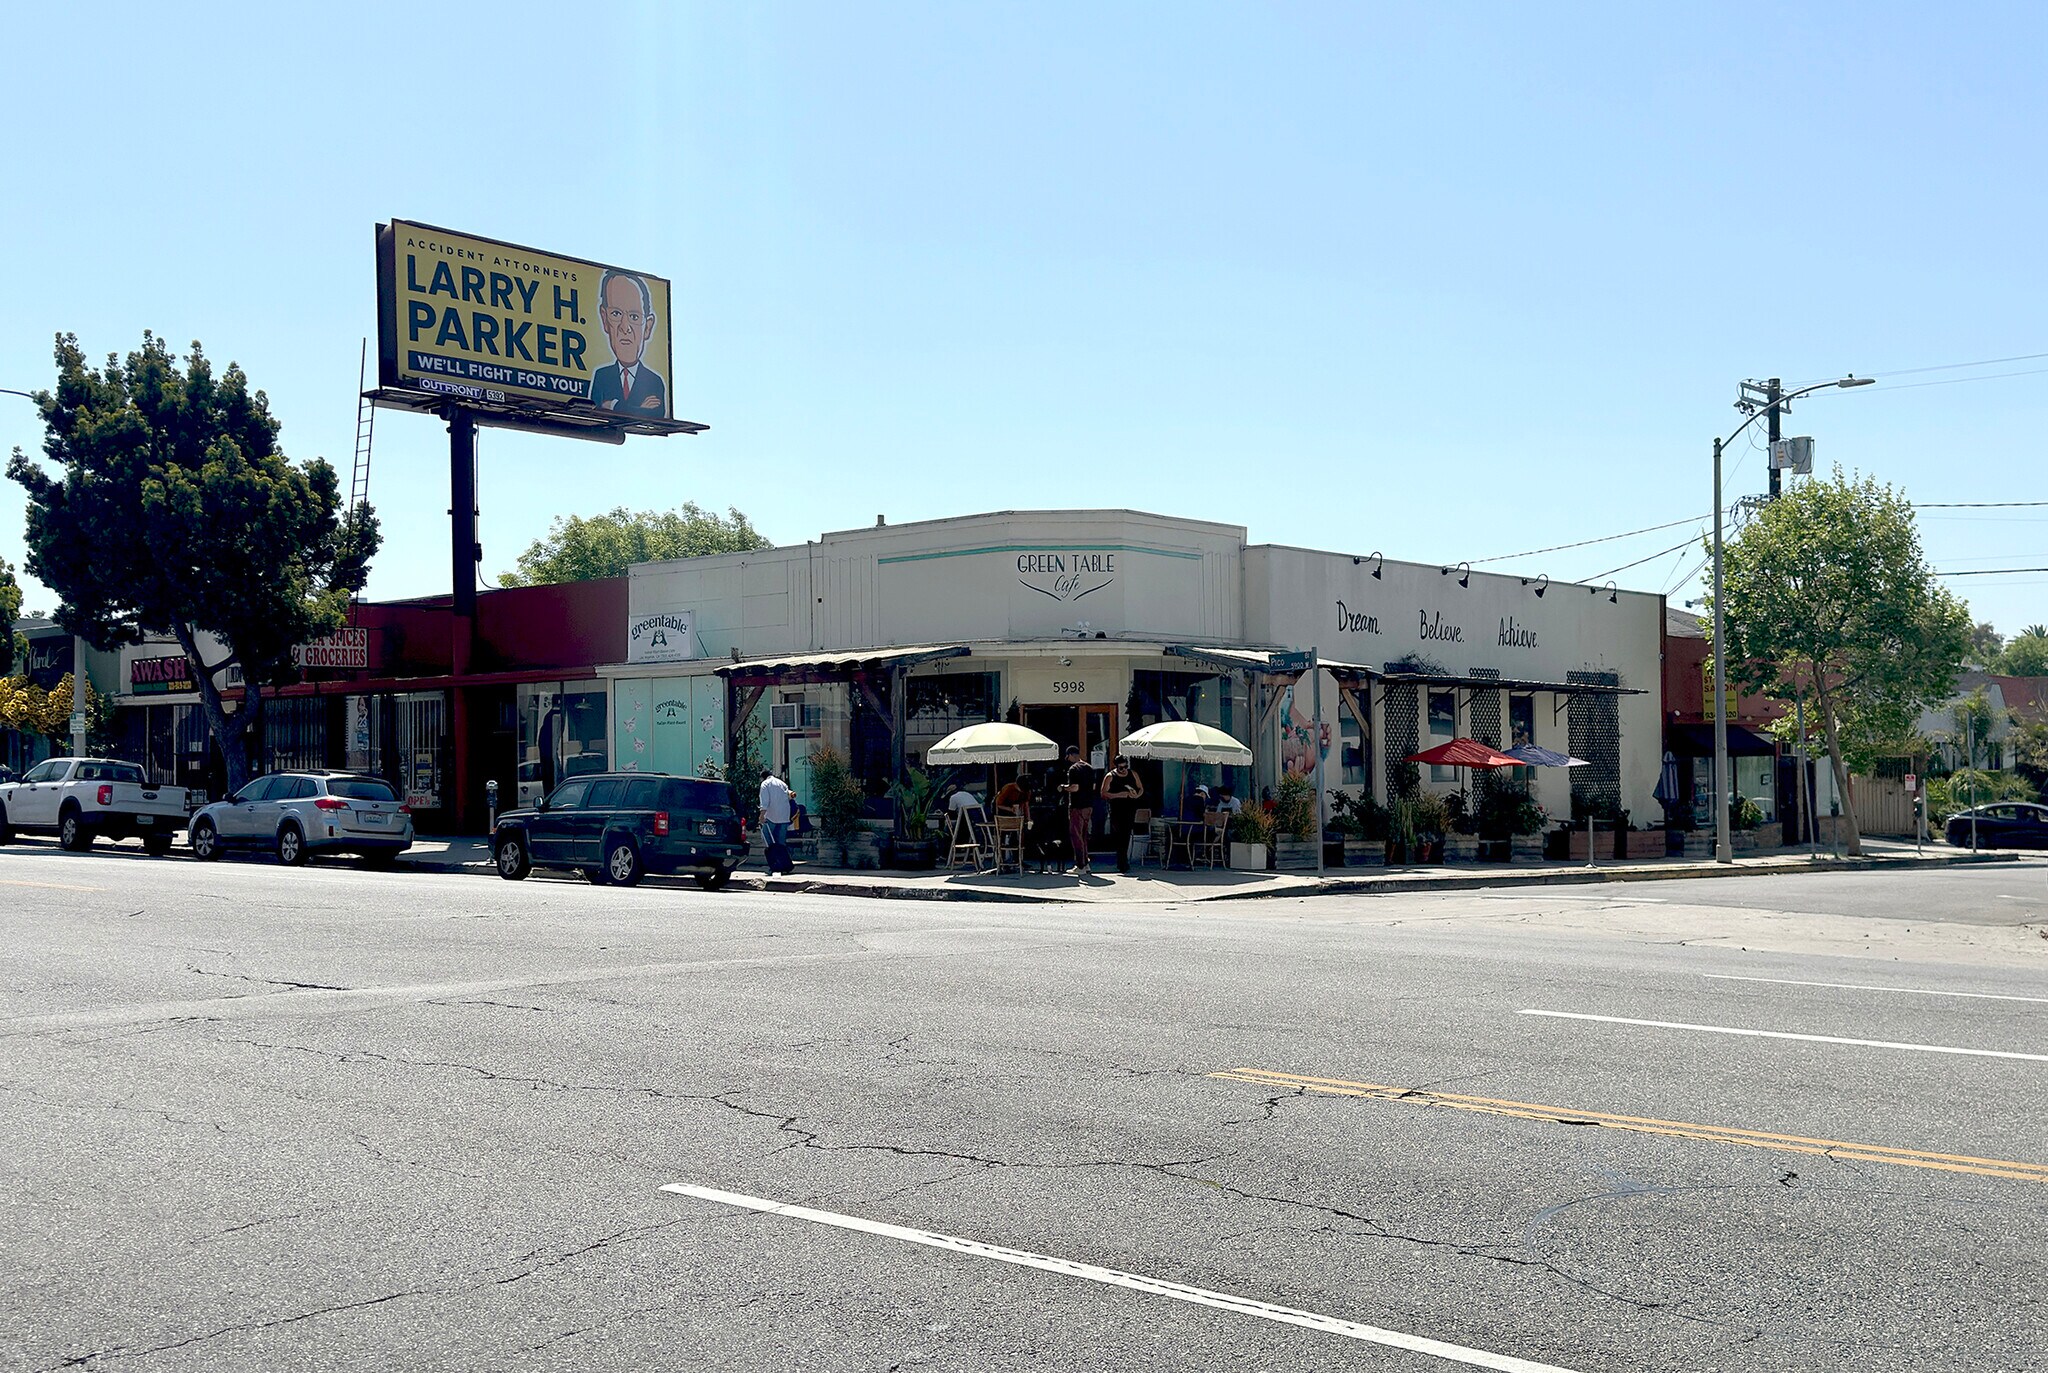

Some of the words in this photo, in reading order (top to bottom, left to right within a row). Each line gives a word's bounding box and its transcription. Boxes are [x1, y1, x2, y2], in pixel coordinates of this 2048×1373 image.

[407, 238, 485, 262] ACCIDENT
[493, 256, 578, 282] ATTORNEYS
[407, 254, 540, 314] LARRY
[553, 284, 587, 325] H.
[408, 299, 588, 371] PARKER
[417, 355, 465, 375] WE'LL
[468, 363, 513, 383] FIGHT
[517, 372, 547, 388] FOR
[550, 378, 583, 394] YOU!
[1017, 554, 1065, 573] GREEN
[1072, 554, 1115, 573] TABLE
[631, 615, 687, 640] greentable
[1336, 600, 1383, 635] Dream.
[1419, 609, 1465, 643] Believe.
[1498, 616, 1540, 649] Achieve.
[131, 658, 186, 682] AWASH
[305, 647, 366, 667] GROCERIES
[1053, 681, 1085, 693] 5998
[1704, 684, 1736, 692] SAON
